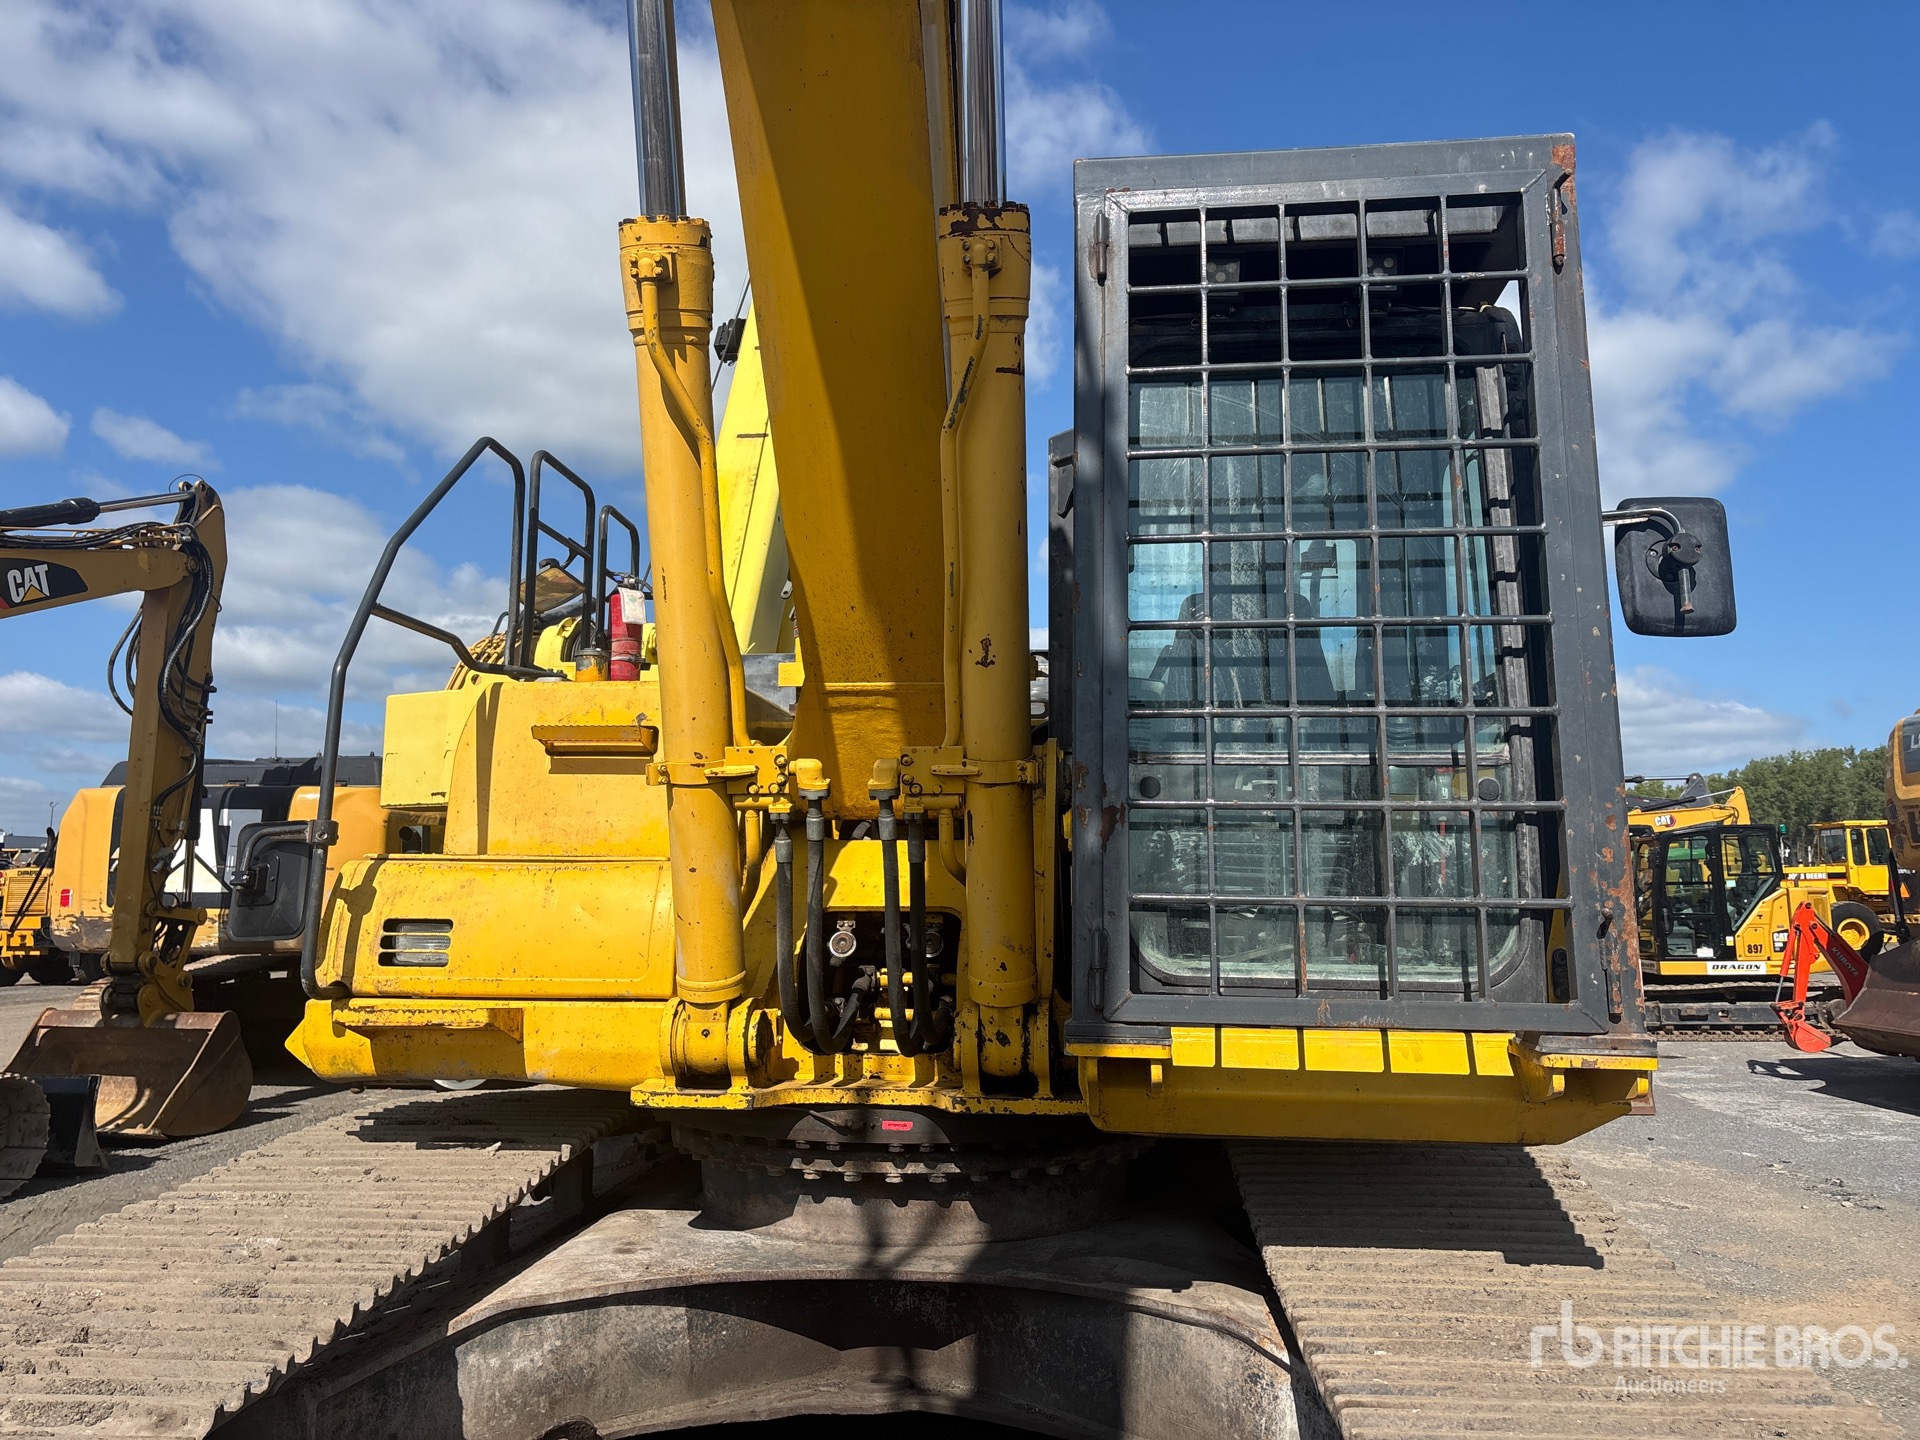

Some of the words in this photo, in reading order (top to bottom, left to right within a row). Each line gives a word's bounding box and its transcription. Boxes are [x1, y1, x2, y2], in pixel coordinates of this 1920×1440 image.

[7, 563, 50, 603] CAT
[1655, 815, 1671, 826] CAT
[1773, 932, 1788, 942] CAT
[1747, 944, 1763, 954] 897
[1832, 946, 1858, 977] KUBOTA
